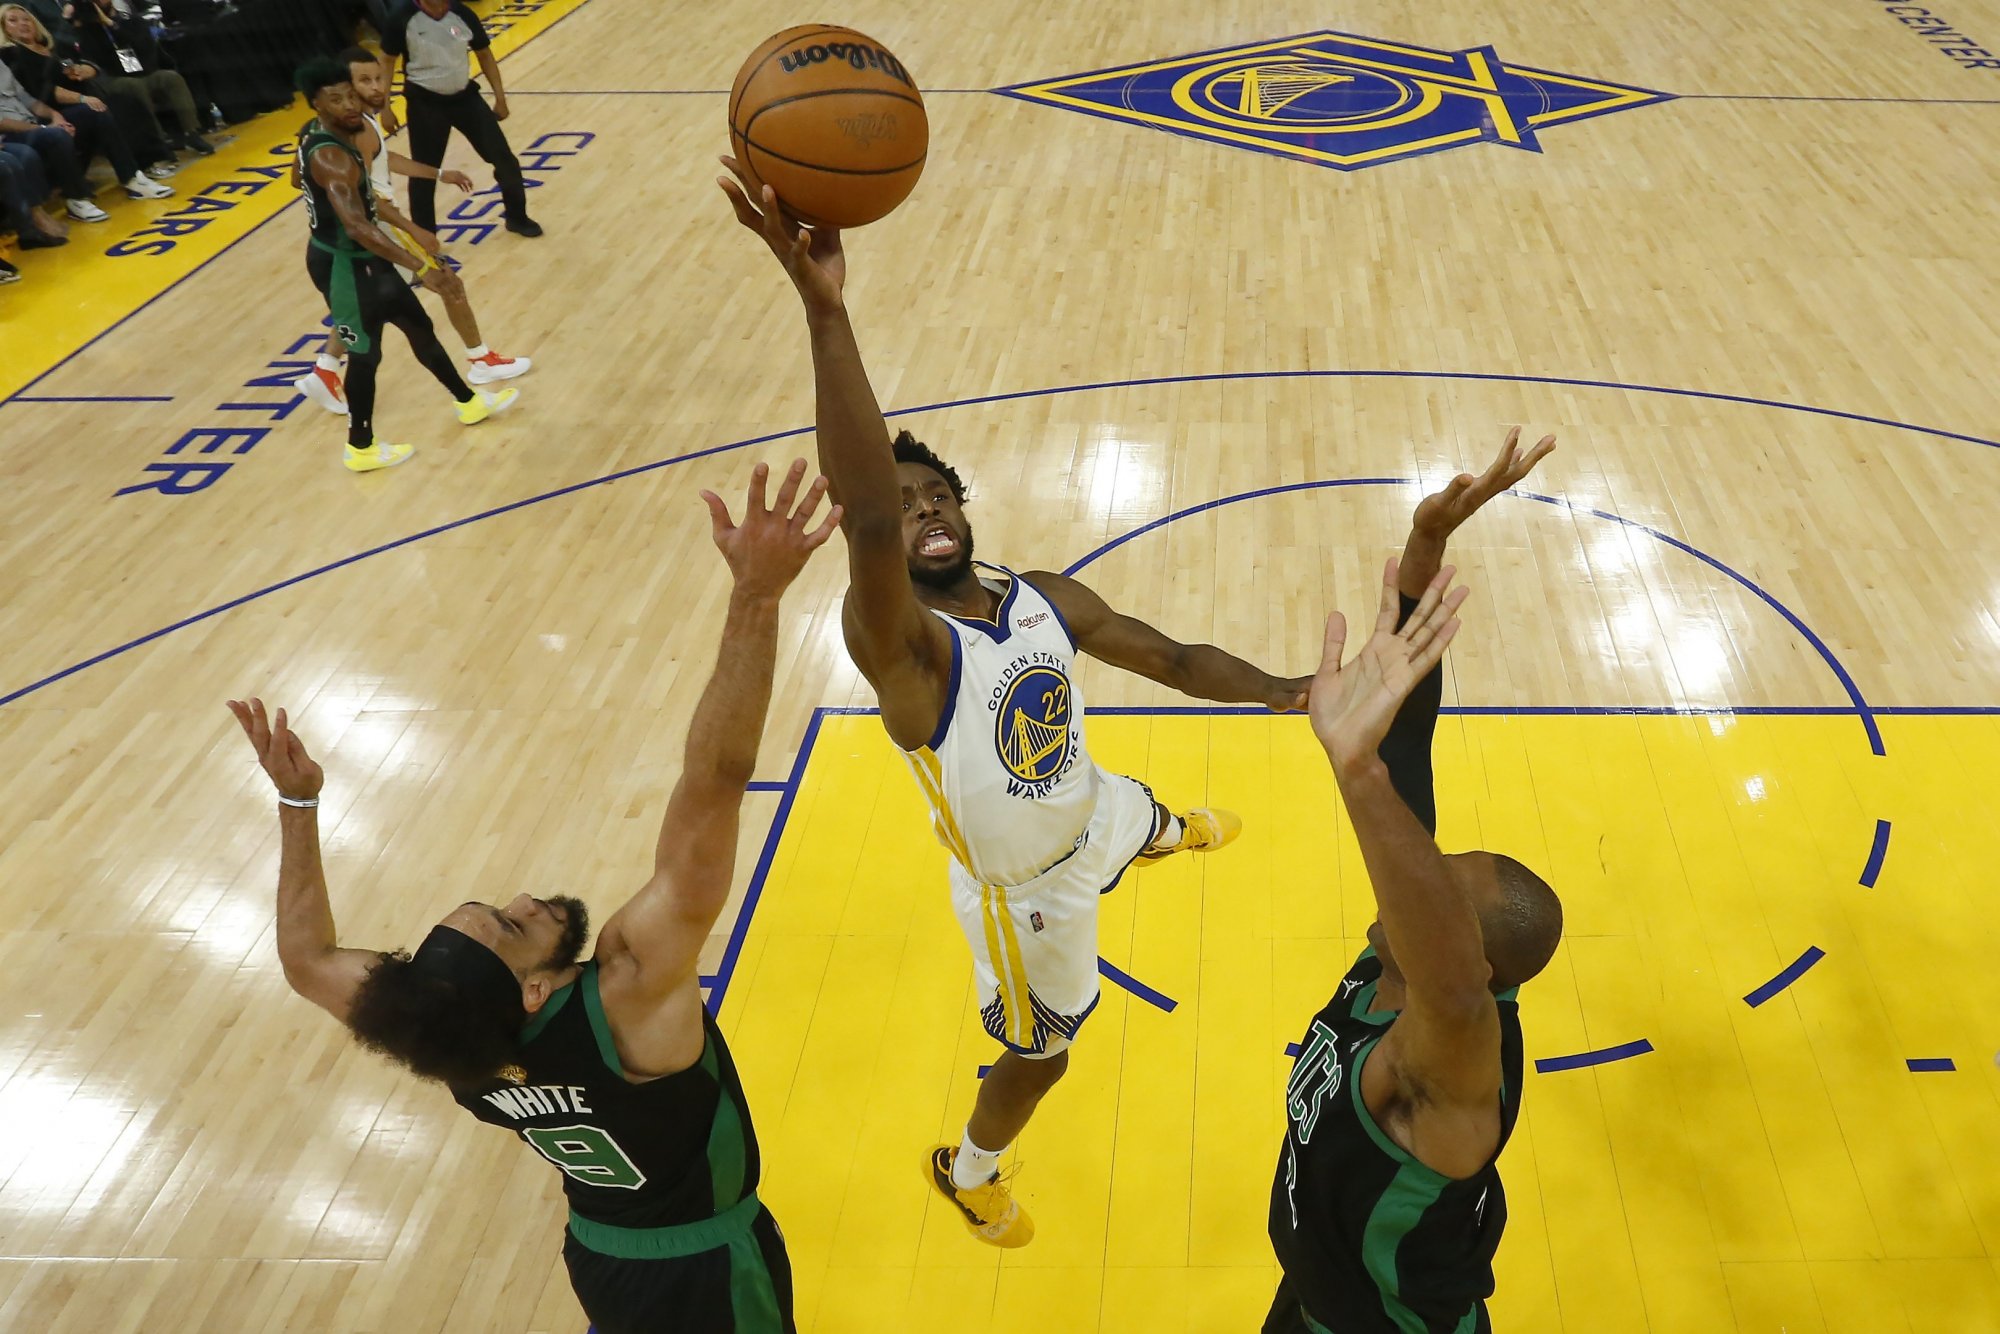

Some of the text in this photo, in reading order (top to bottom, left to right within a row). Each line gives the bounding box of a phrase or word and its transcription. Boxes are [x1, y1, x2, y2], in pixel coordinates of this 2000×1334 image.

[778, 42, 912, 88] Wilson
[104, 163, 294, 257] YEARS
[111, 314, 348, 497] ENTER
[1017, 612, 1050, 629] Rakuten
[987, 652, 1067, 711] GOLDEN STATE
[1041, 684, 1067, 724] 22
[481, 1085, 593, 1120] WHITE
[522, 1124, 648, 1191] 9
